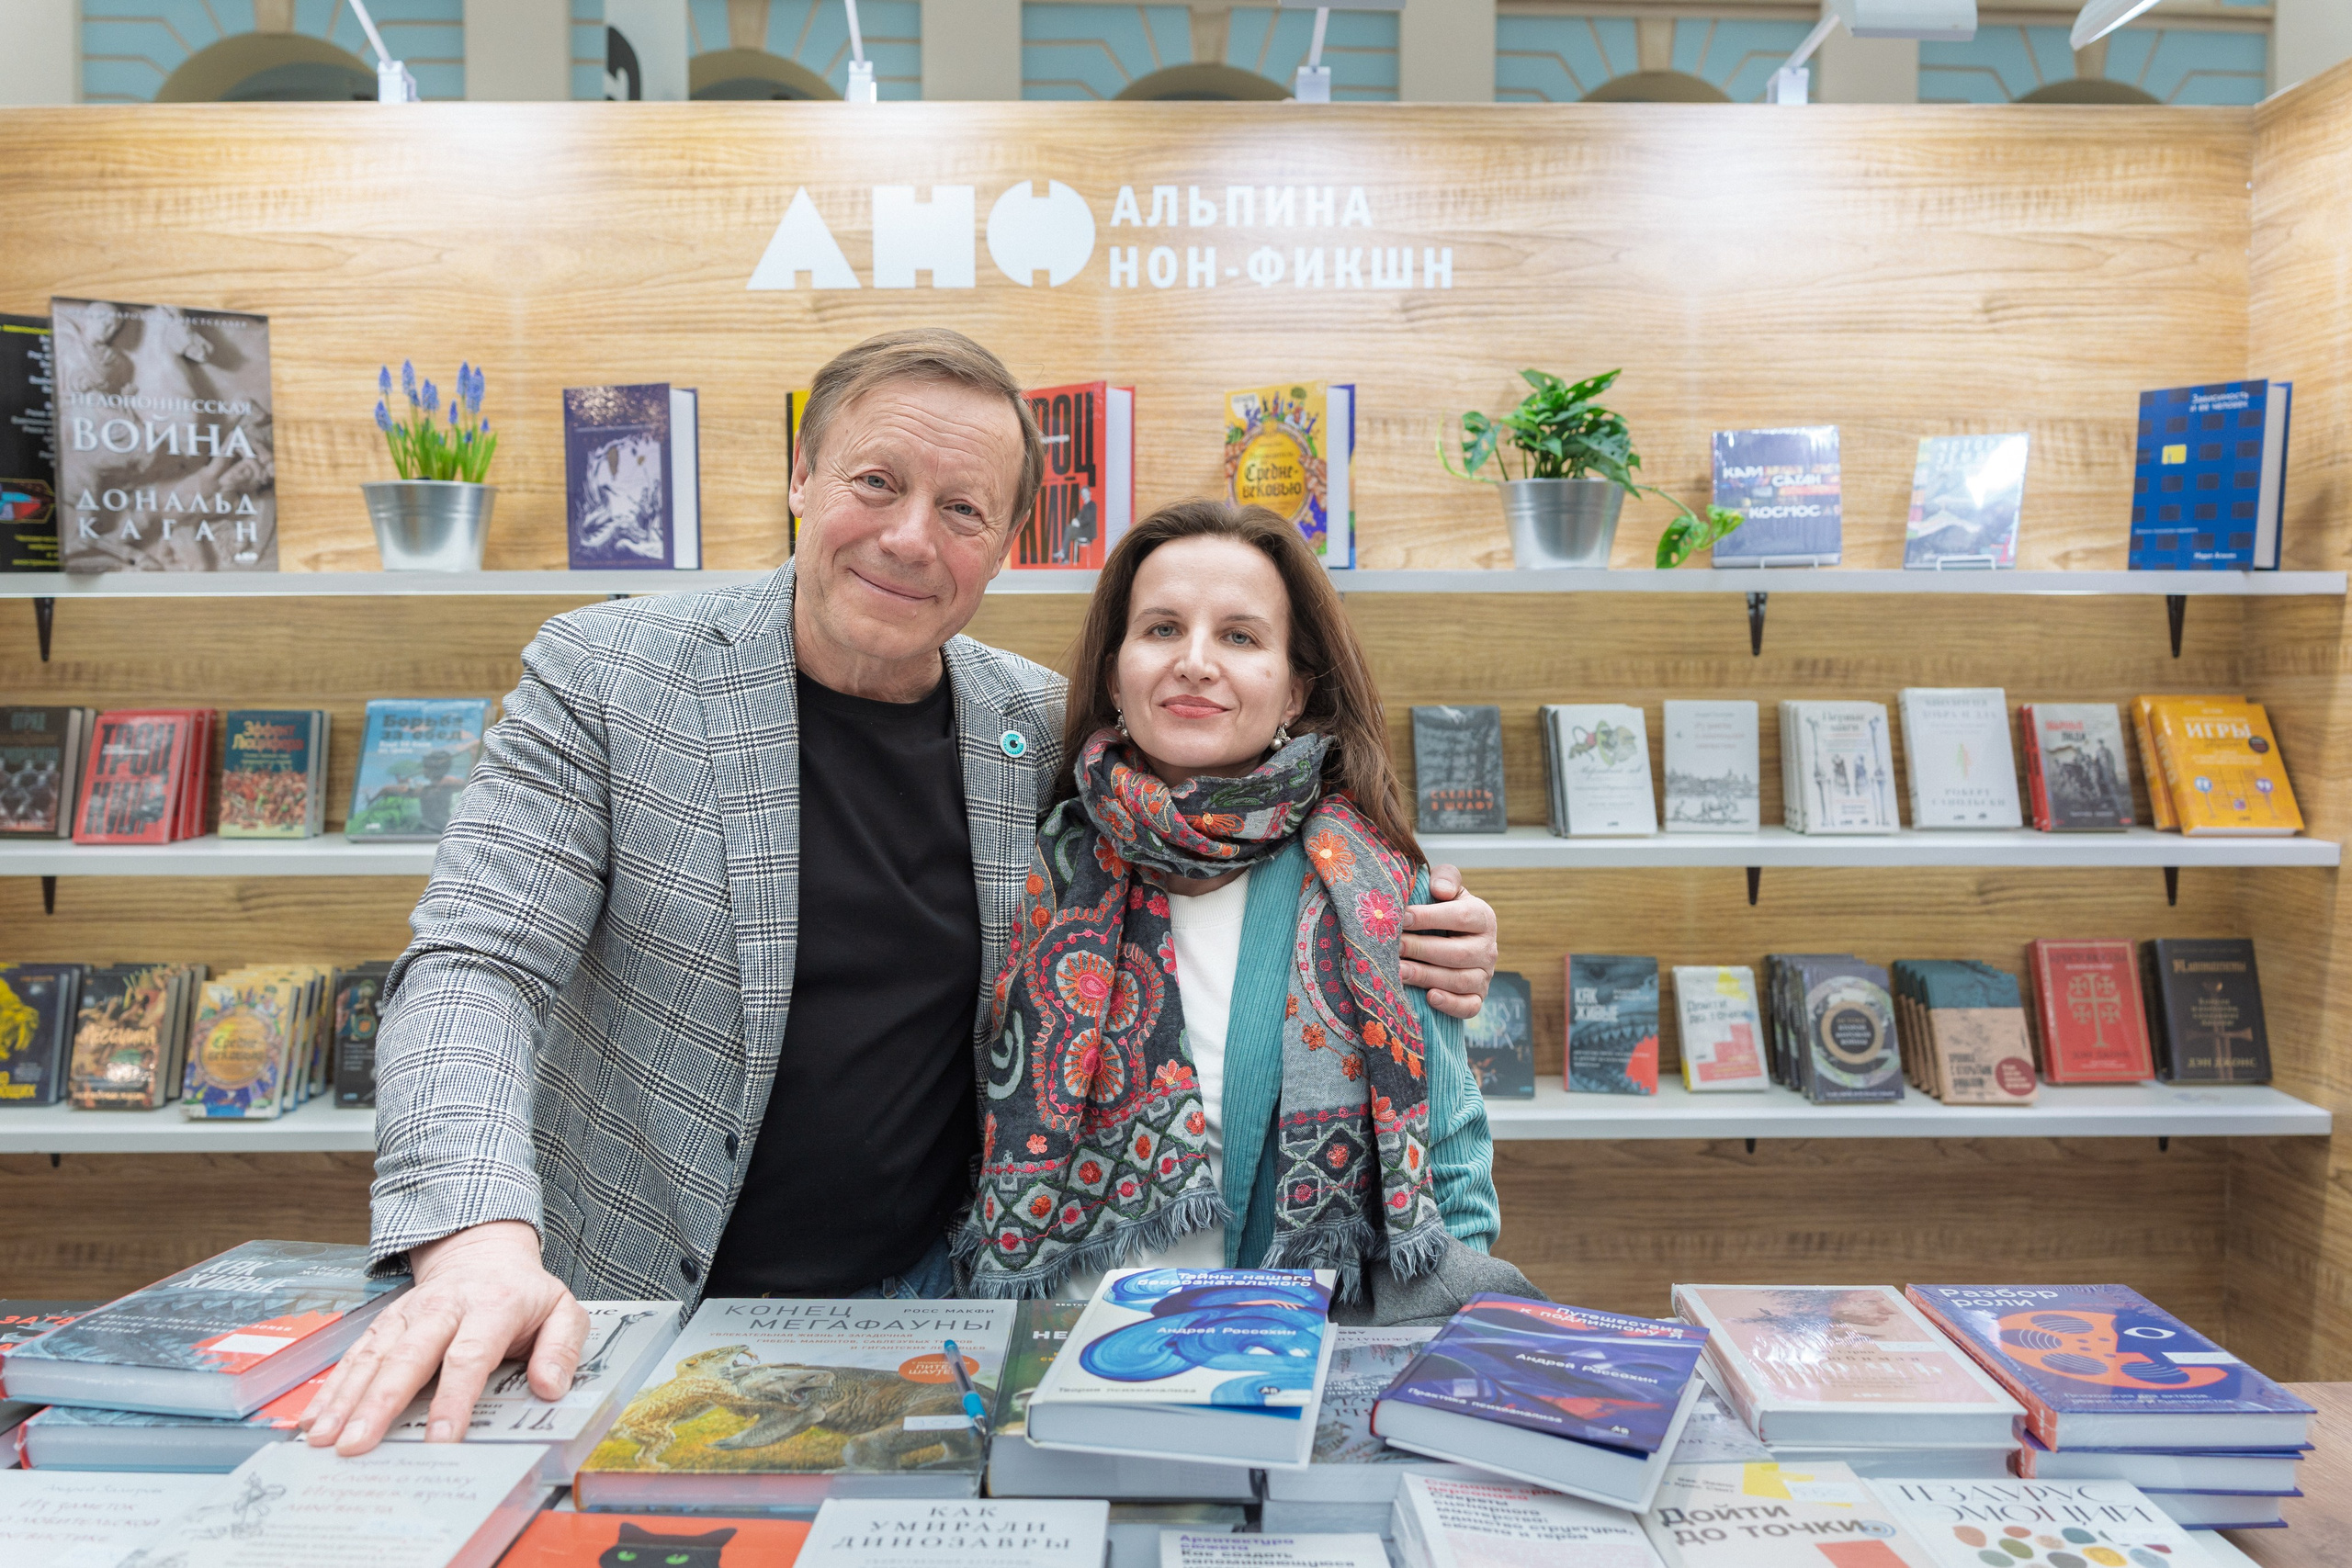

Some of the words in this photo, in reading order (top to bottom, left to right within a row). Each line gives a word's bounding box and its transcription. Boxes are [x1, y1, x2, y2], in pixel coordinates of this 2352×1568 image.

[1110, 185, 1373, 227] АЛЬПИНА
[1110, 245, 1453, 288] НОН-ФИКШН
[70, 392, 254, 416] ПЕЛОПОННЕССКАЯ
[73, 414, 257, 458] ВОЙНА
[1245, 464, 1299, 482] Средне-
[1242, 482, 1302, 499] вековью
[77, 489, 258, 514] ДОНАЛЬД
[1748, 504, 1821, 519] КОСМОС
[79, 517, 258, 542] КАГАН
[383, 715, 463, 729] Борьба
[2186, 723, 2252, 739] ИГРЫ
[96, 724, 176, 784] ТРОЦ
[1430, 789, 1494, 800] СКЕЛЕТЫ
[1430, 800, 1440, 811] В
[1443, 800, 1494, 811] ШКАФУ
[199, 1260, 275, 1276] КАК
[298, 1270, 365, 1279] ЖУРАВЛ
[308, 1265, 363, 1273] АНДРЕ
[167, 1273, 297, 1293] ЖИВЫЕ
[1137, 1279, 1311, 1288] бессознательного
[1178, 1272, 1234, 1280] Тайны
[1242, 1274, 1313, 1282] нашего
[1938, 1287, 2059, 1302] Разбор
[1951, 1295, 2035, 1309] роли
[0, 1314, 77, 1325] ЗАГА
[725, 1305, 853, 1319] КОНЕЦ
[1556, 1307, 1684, 1333] Путешествие
[750, 1319, 990, 1331] МЕГАФАУНЫ
[1157, 1326, 1216, 1336] Андрей
[1222, 1327, 1296, 1337] Россохин
[1539, 1311, 1659, 1337] подлинному
[1668, 1331, 1683, 1340] Я
[1033, 1330, 1069, 1339] НЕ
[1516, 1353, 1575, 1370] Андрей
[1582, 1365, 1658, 1384] Россохин
[1408, 1387, 1467, 1404] Практика
[1472, 1400, 1563, 1424] психоанализа
[1423, 1477, 1513, 1494] Создание
[1428, 1485, 1529, 1502] персонажа
[1430, 1491, 1509, 1506] Секреты
[929, 1506, 1000, 1518] КАК
[1433, 1499, 1541, 1516] сценарного
[870, 1520, 1048, 1535] УМИРАЛИ
[1439, 1515, 1523, 1530] единство
[1529, 1524, 1634, 1537] структуры,
[1442, 1521, 1512, 1537] сюжета
[1537, 1531, 1589, 1541] героя
[831, 1535, 1071, 1551] ДИНОЗАВРЫ
[1181, 1534, 1295, 1546] Архитектура
